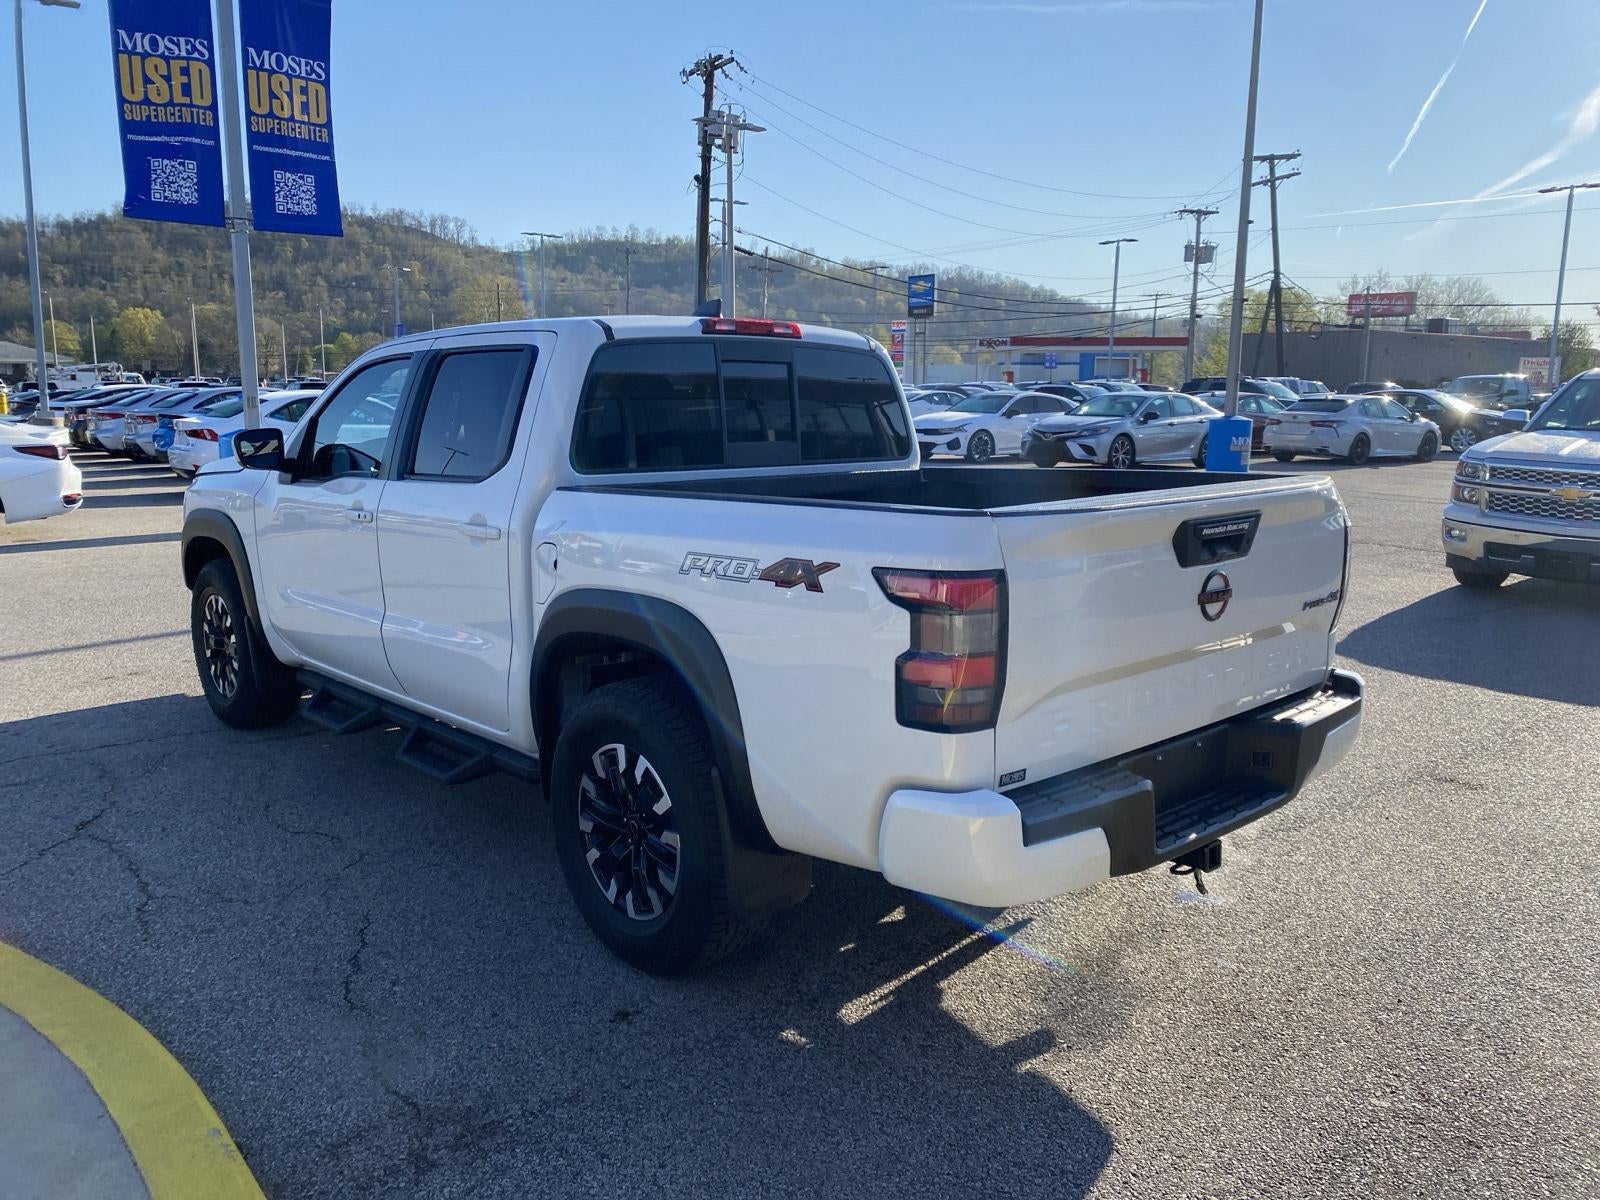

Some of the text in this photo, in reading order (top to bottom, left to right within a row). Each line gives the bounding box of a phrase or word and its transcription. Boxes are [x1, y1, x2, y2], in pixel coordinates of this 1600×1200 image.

[117, 29, 210, 60] MOSES
[247, 47, 326, 81] MOSES
[118, 53, 213, 107] USED
[247, 69, 328, 125] USED
[123, 103, 214, 127] SUPERCENTER
[251, 116, 329, 144] SUPERCENTER
[978, 338, 1008, 349] EXXON
